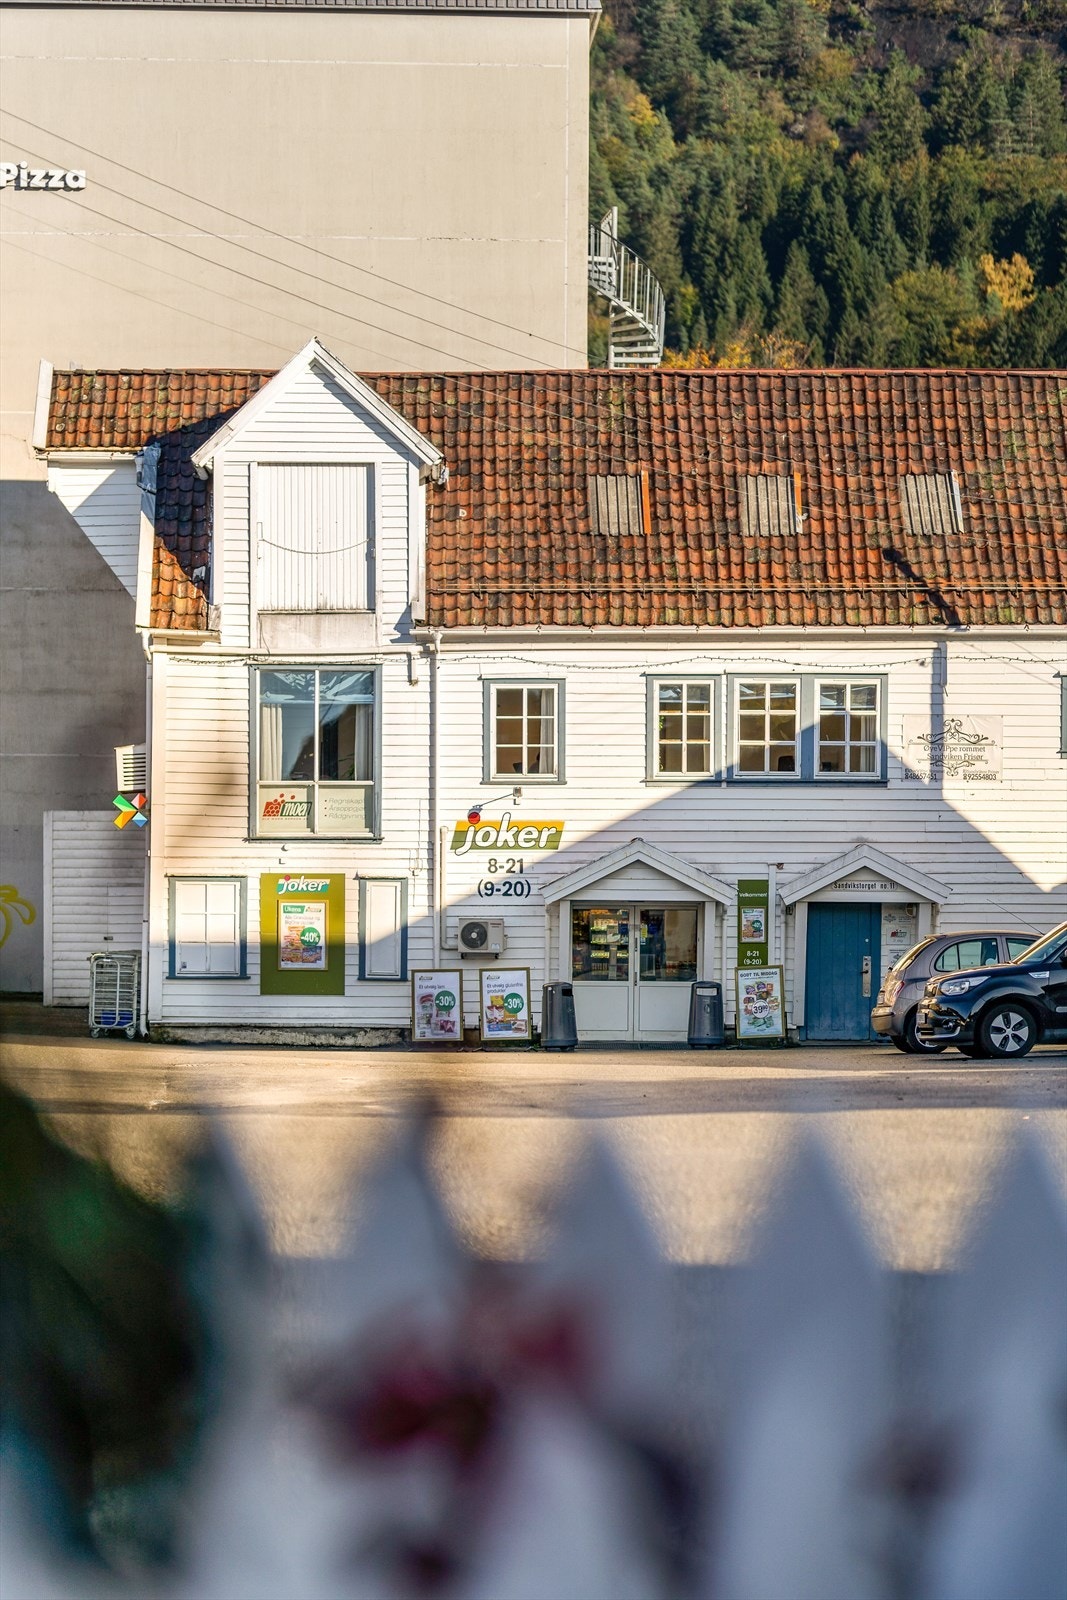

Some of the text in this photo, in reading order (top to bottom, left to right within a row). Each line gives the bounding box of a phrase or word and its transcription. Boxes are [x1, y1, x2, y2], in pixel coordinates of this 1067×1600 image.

[0, 161, 86, 189] Pizza
[959, 745, 986, 753] rommet
[454, 812, 558, 856] joker
[488, 858, 524, 874] 8-21
[278, 874, 328, 895] joker
[477, 879, 531, 898] (9-20)
[833, 881, 877, 890] Sandvikstorget
[300, 932, 319, 943] -40%
[435, 995, 455, 1006] -30%
[504, 998, 523, 1008] -30%
